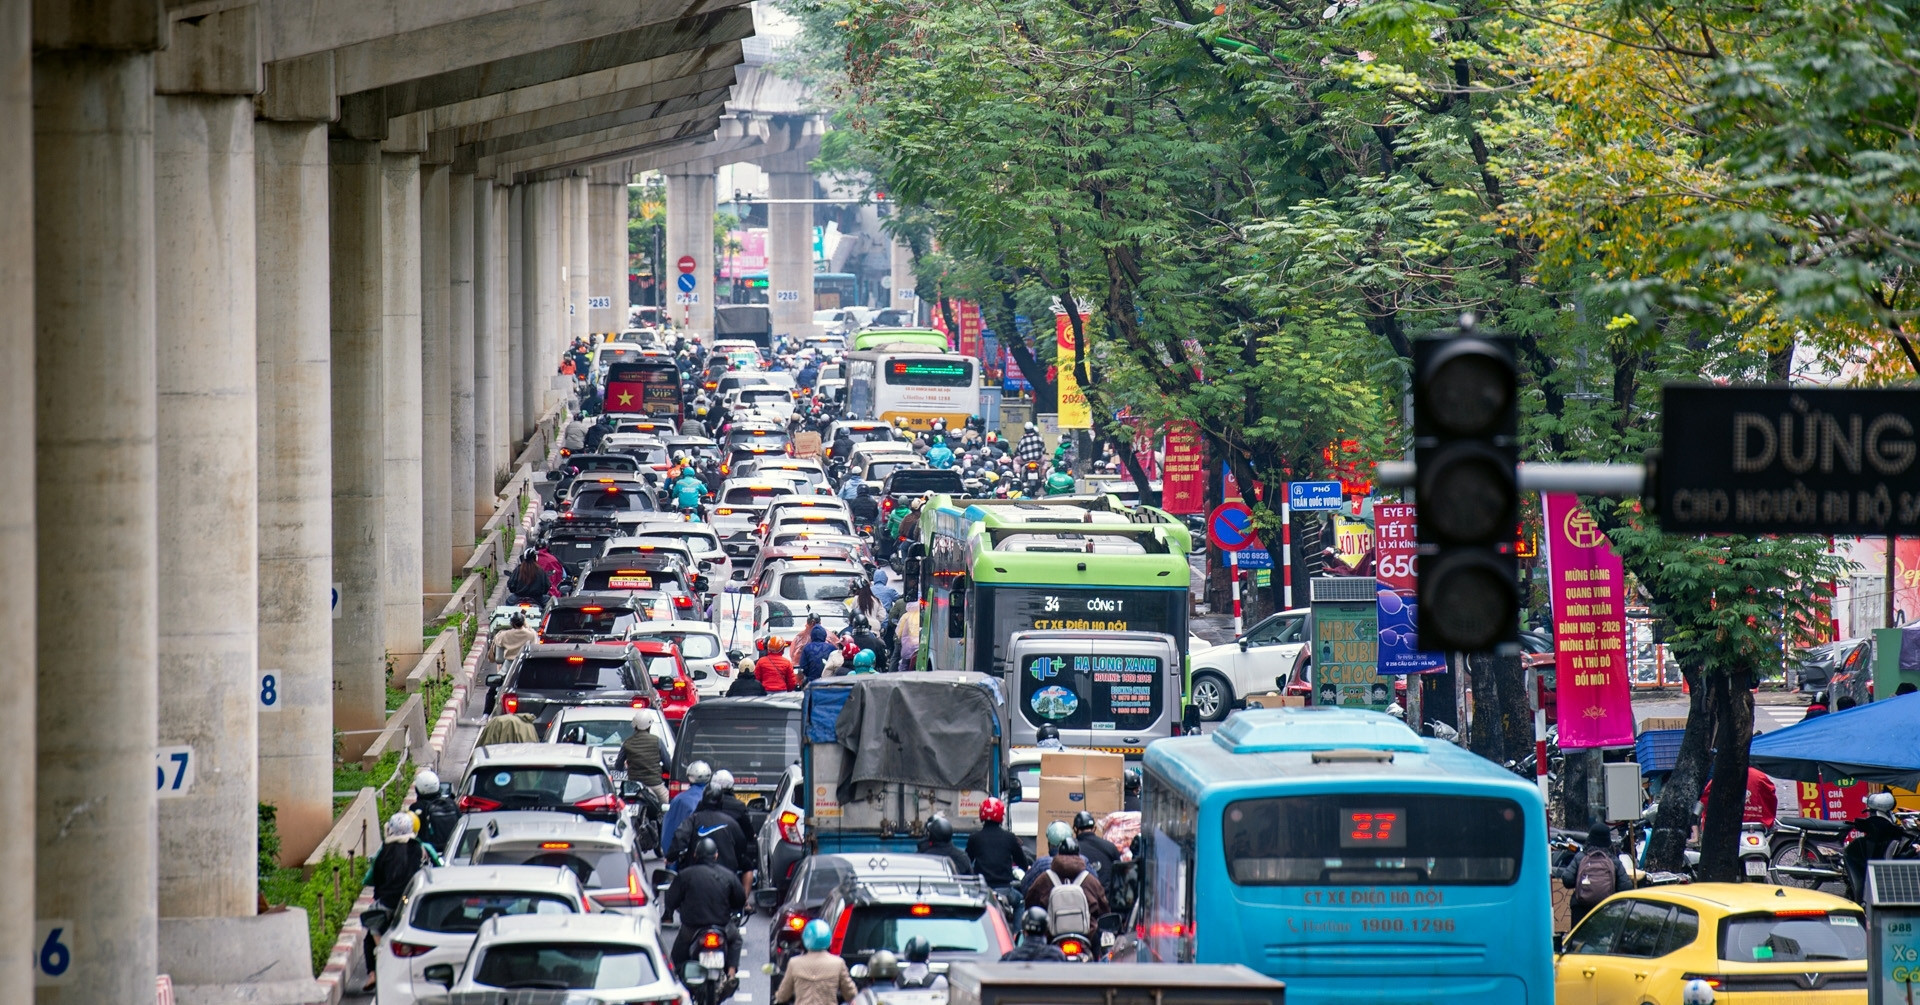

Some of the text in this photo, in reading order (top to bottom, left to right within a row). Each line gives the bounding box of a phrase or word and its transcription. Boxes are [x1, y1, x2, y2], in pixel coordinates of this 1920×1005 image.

[1733, 393, 1917, 476] DỪNG
[1312, 484, 1331, 493] PHỐ
[1308, 495, 1323, 508] QUỐC
[1899, 490, 1920, 523] S
[1383, 506, 1419, 518] EYE PL
[1378, 521, 1408, 538] TẾT
[1339, 530, 1356, 555] XÔI
[1378, 541, 1387, 549] LÌ
[1388, 540, 1398, 549] XÌ
[1565, 564, 1610, 581] MỪNG ĐẢNG
[1566, 586, 1611, 600] QUANG VINH
[1044, 596, 1060, 612] 34
[1087, 597, 1124, 612] CÔNG T
[1566, 601, 1612, 616] MỪNG XUÂN
[1034, 620, 1049, 630] CT
[1050, 620, 1064, 631] XE
[1319, 620, 1357, 641] NBK
[1579, 622, 1596, 636] NGỌ
[1601, 621, 1621, 632] 2026
[1560, 635, 1621, 651] MỪNG ĐẤT NƯỚC
[1333, 641, 1378, 662] RUBI
[1074, 656, 1157, 674] HẠ LONG XANH
[1572, 652, 1611, 669] VÀ THỦ ĐÔ
[1094, 673, 1121, 682] HOTLINE:
[1590, 671, 1605, 685] MỚI
[1606, 673, 1610, 685] !
[261, 675, 276, 705] 8
[1828, 788, 1844, 798] CHẢ
[1828, 800, 1842, 808] GIÒ
[1829, 811, 1847, 820] MỌC
[1352, 813, 1397, 839] 27
[1304, 890, 1322, 904] CT
[1327, 890, 1346, 904] XE
[1351, 886, 1386, 909] ĐIỆN
[1390, 886, 1410, 904] HÀ
[1303, 918, 1455, 932] Hotline 1900.1296
[34, 927, 70, 977] 6
[1892, 944, 1918, 961] Xe
